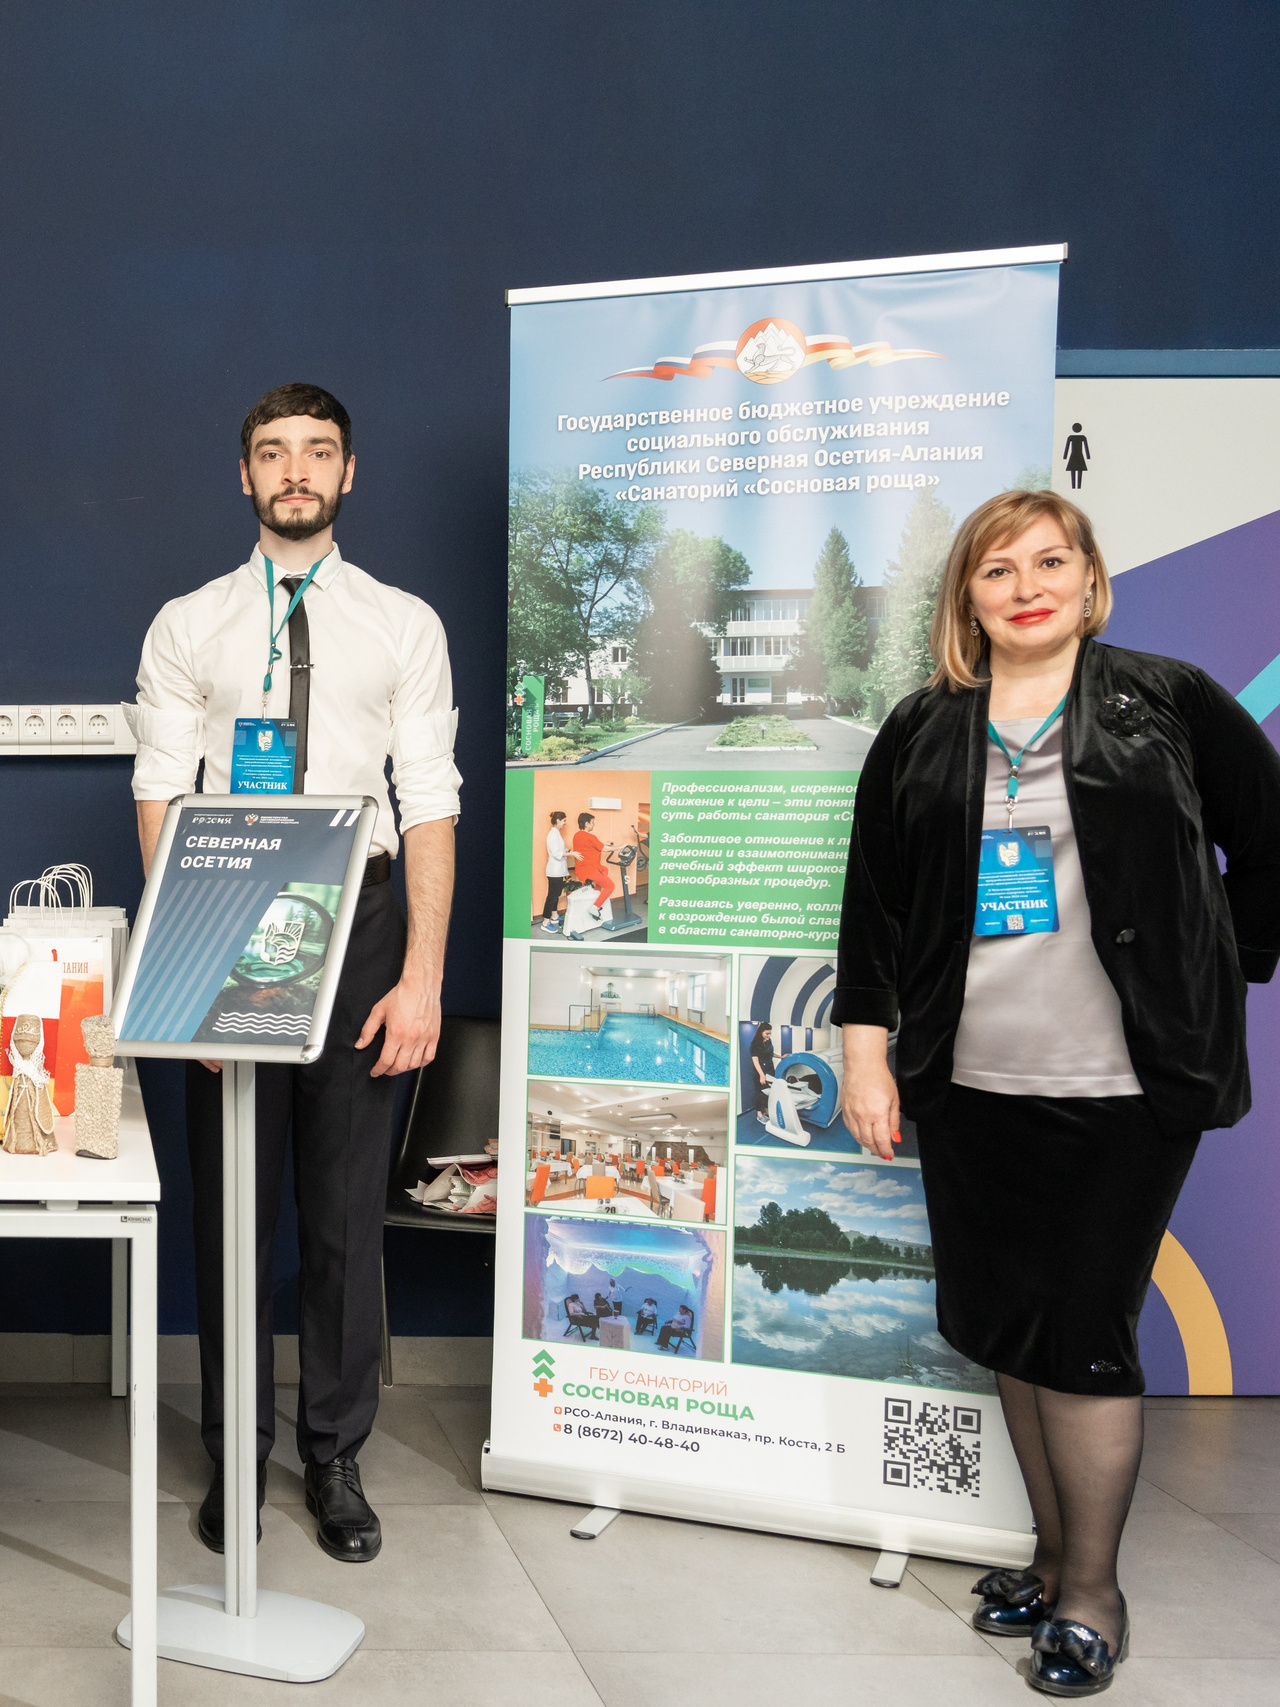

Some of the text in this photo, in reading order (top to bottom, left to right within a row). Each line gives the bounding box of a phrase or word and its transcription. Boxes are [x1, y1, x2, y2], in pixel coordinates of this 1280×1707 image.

[557, 390, 1010, 434] Государственное бюджетное учреждение
[626, 421, 930, 452] социального обслуживания
[578, 445, 984, 480] Республики Северная Осетия-Алания
[615, 473, 940, 502] «Санаторий «Сосновая роща»
[237, 781, 288, 790] УЧАСТНИК
[662, 782, 786, 795] Профессионализм,
[662, 796, 726, 807] движение
[727, 799, 735, 807] к
[738, 799, 771, 809] цели
[784, 799, 812, 808] эти
[661, 812, 695, 822] суть
[697, 810, 752, 822] работы
[755, 812, 830, 823] санатория
[185, 835, 282, 850] СЕВЕРНАЯ
[660, 833, 742, 844] Заботливое
[745, 836, 824, 846] отношение
[827, 837, 835, 846] к
[660, 849, 723, 860] гармонии
[726, 849, 734, 859] и
[180, 855, 253, 870] ОСЕТИЯ
[659, 861, 724, 871] лечебный
[727, 863, 783, 875] эффект
[659, 874, 832, 889] разнообразных процедур.
[658, 897, 734, 909] Развиваясь
[737, 901, 803, 913] уверенно,
[980, 899, 1048, 912] УЧАСТНИК
[658, 912, 666, 920] к
[668, 911, 758, 924] возрождению
[761, 913, 806, 925] былой
[658, 926, 666, 934] в
[669, 925, 727, 936] области
[589, 1366, 729, 1397] ГБУ САНАТОРИЙ
[562, 1382, 756, 1421] СОСНОВАЯ РОЩА
[564, 1406, 646, 1428] РСО-Алания,
[649, 1420, 658, 1428] г.
[754, 1433, 775, 1445] пр.
[779, 1436, 821, 1452] Коста,
[824, 1442, 833, 1452] 2
[836, 1443, 846, 1454] Б
[563, 1423, 701, 1453] 8 (8672) 40-48-40
